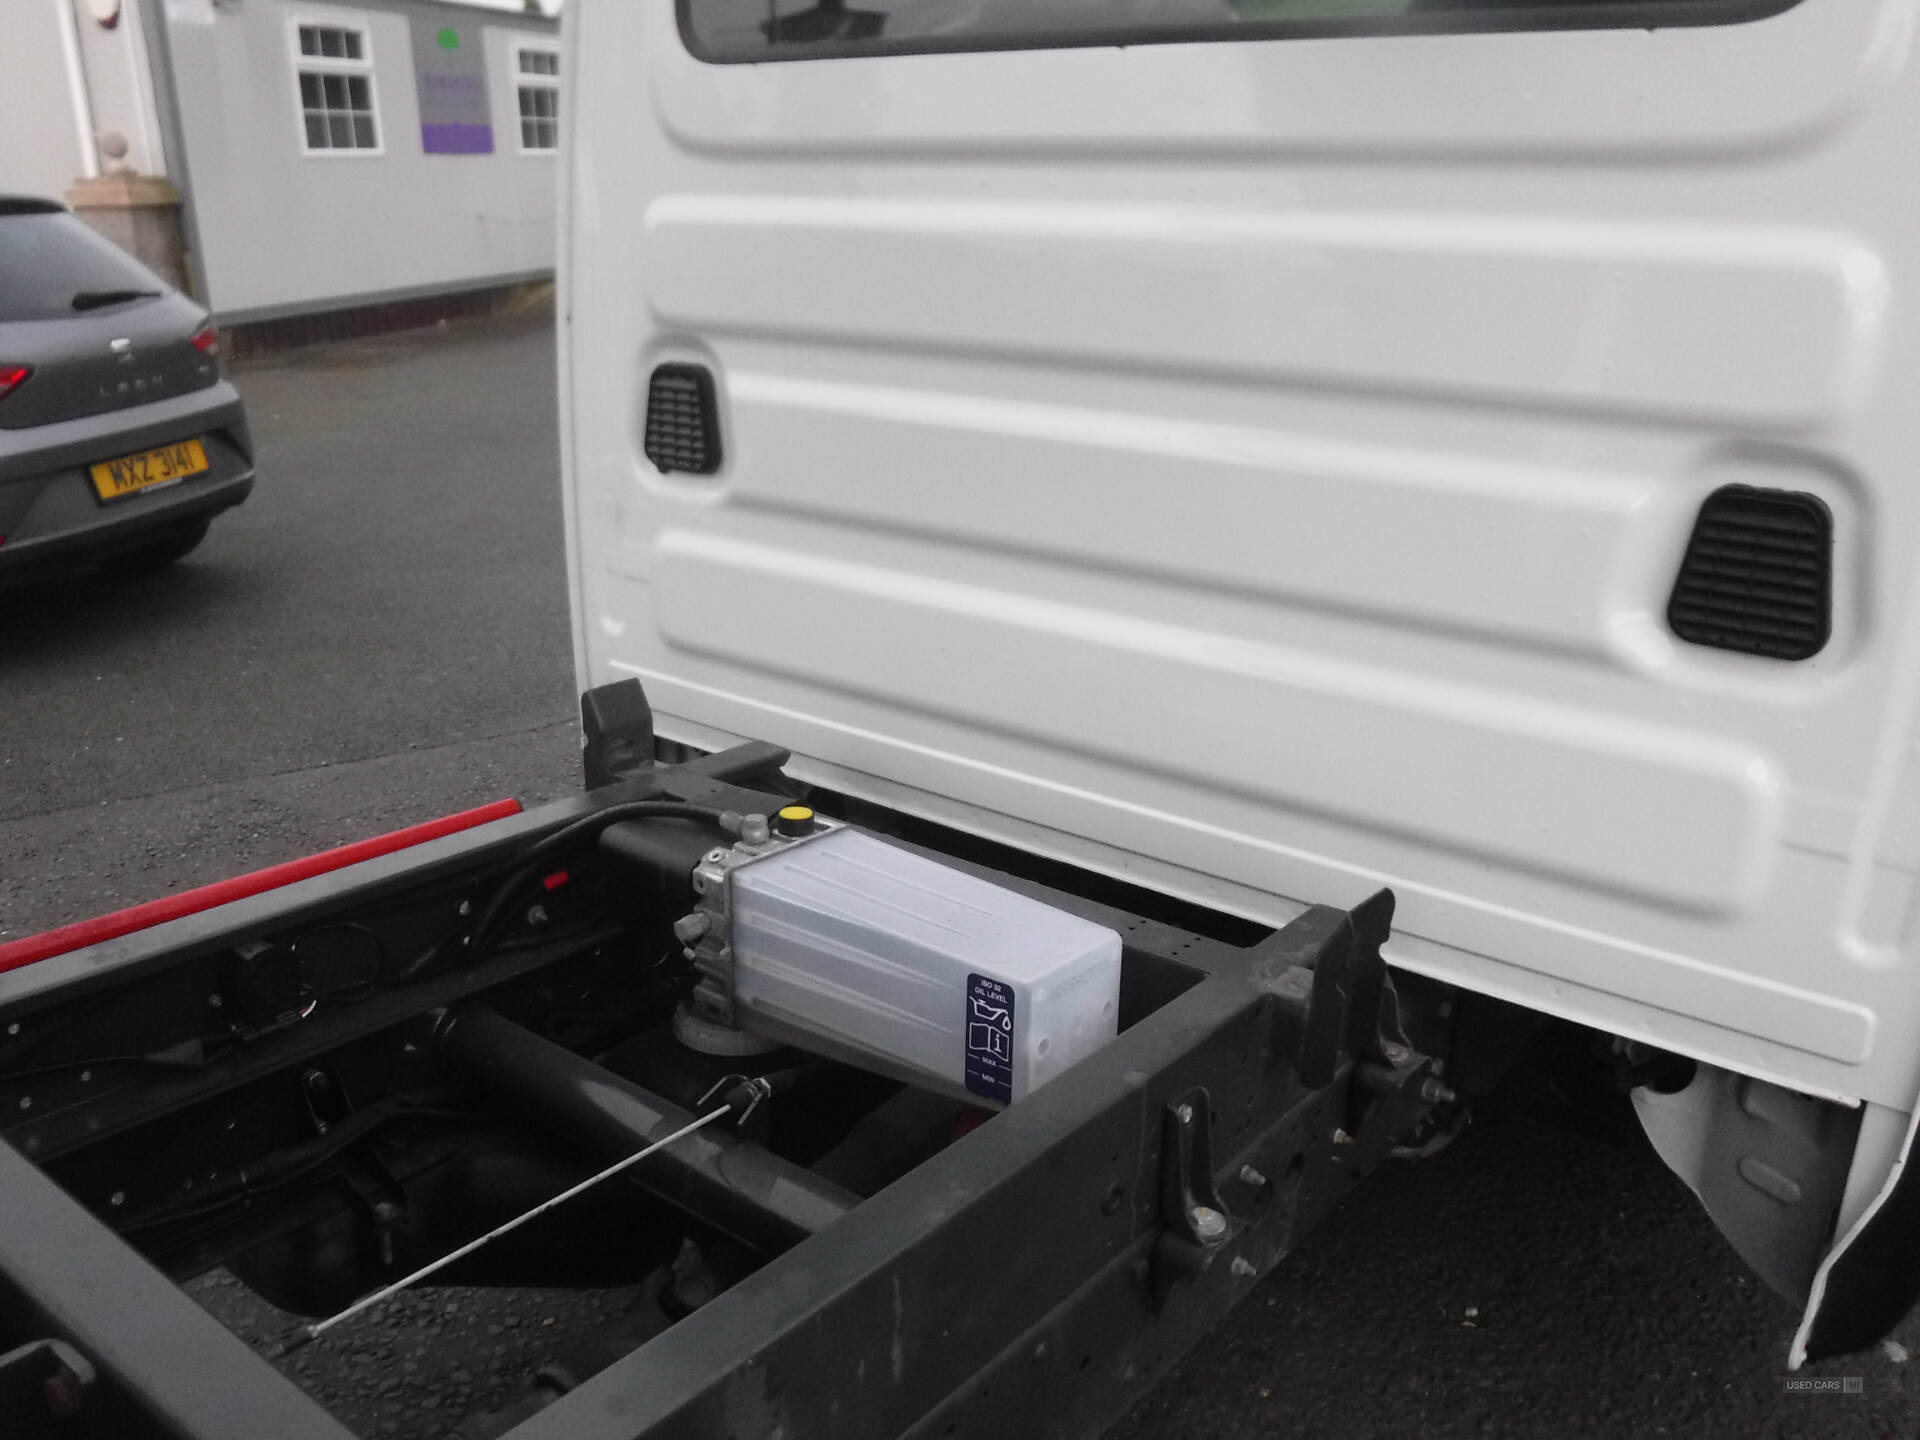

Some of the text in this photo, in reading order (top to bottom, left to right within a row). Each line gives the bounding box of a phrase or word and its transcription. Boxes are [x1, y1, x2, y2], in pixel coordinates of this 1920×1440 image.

[981, 980, 992, 989] ISO
[974, 986, 1007, 1003] OIL LEVEL
[982, 1056, 996, 1067] MAX
[982, 1072, 994, 1083] MIN
